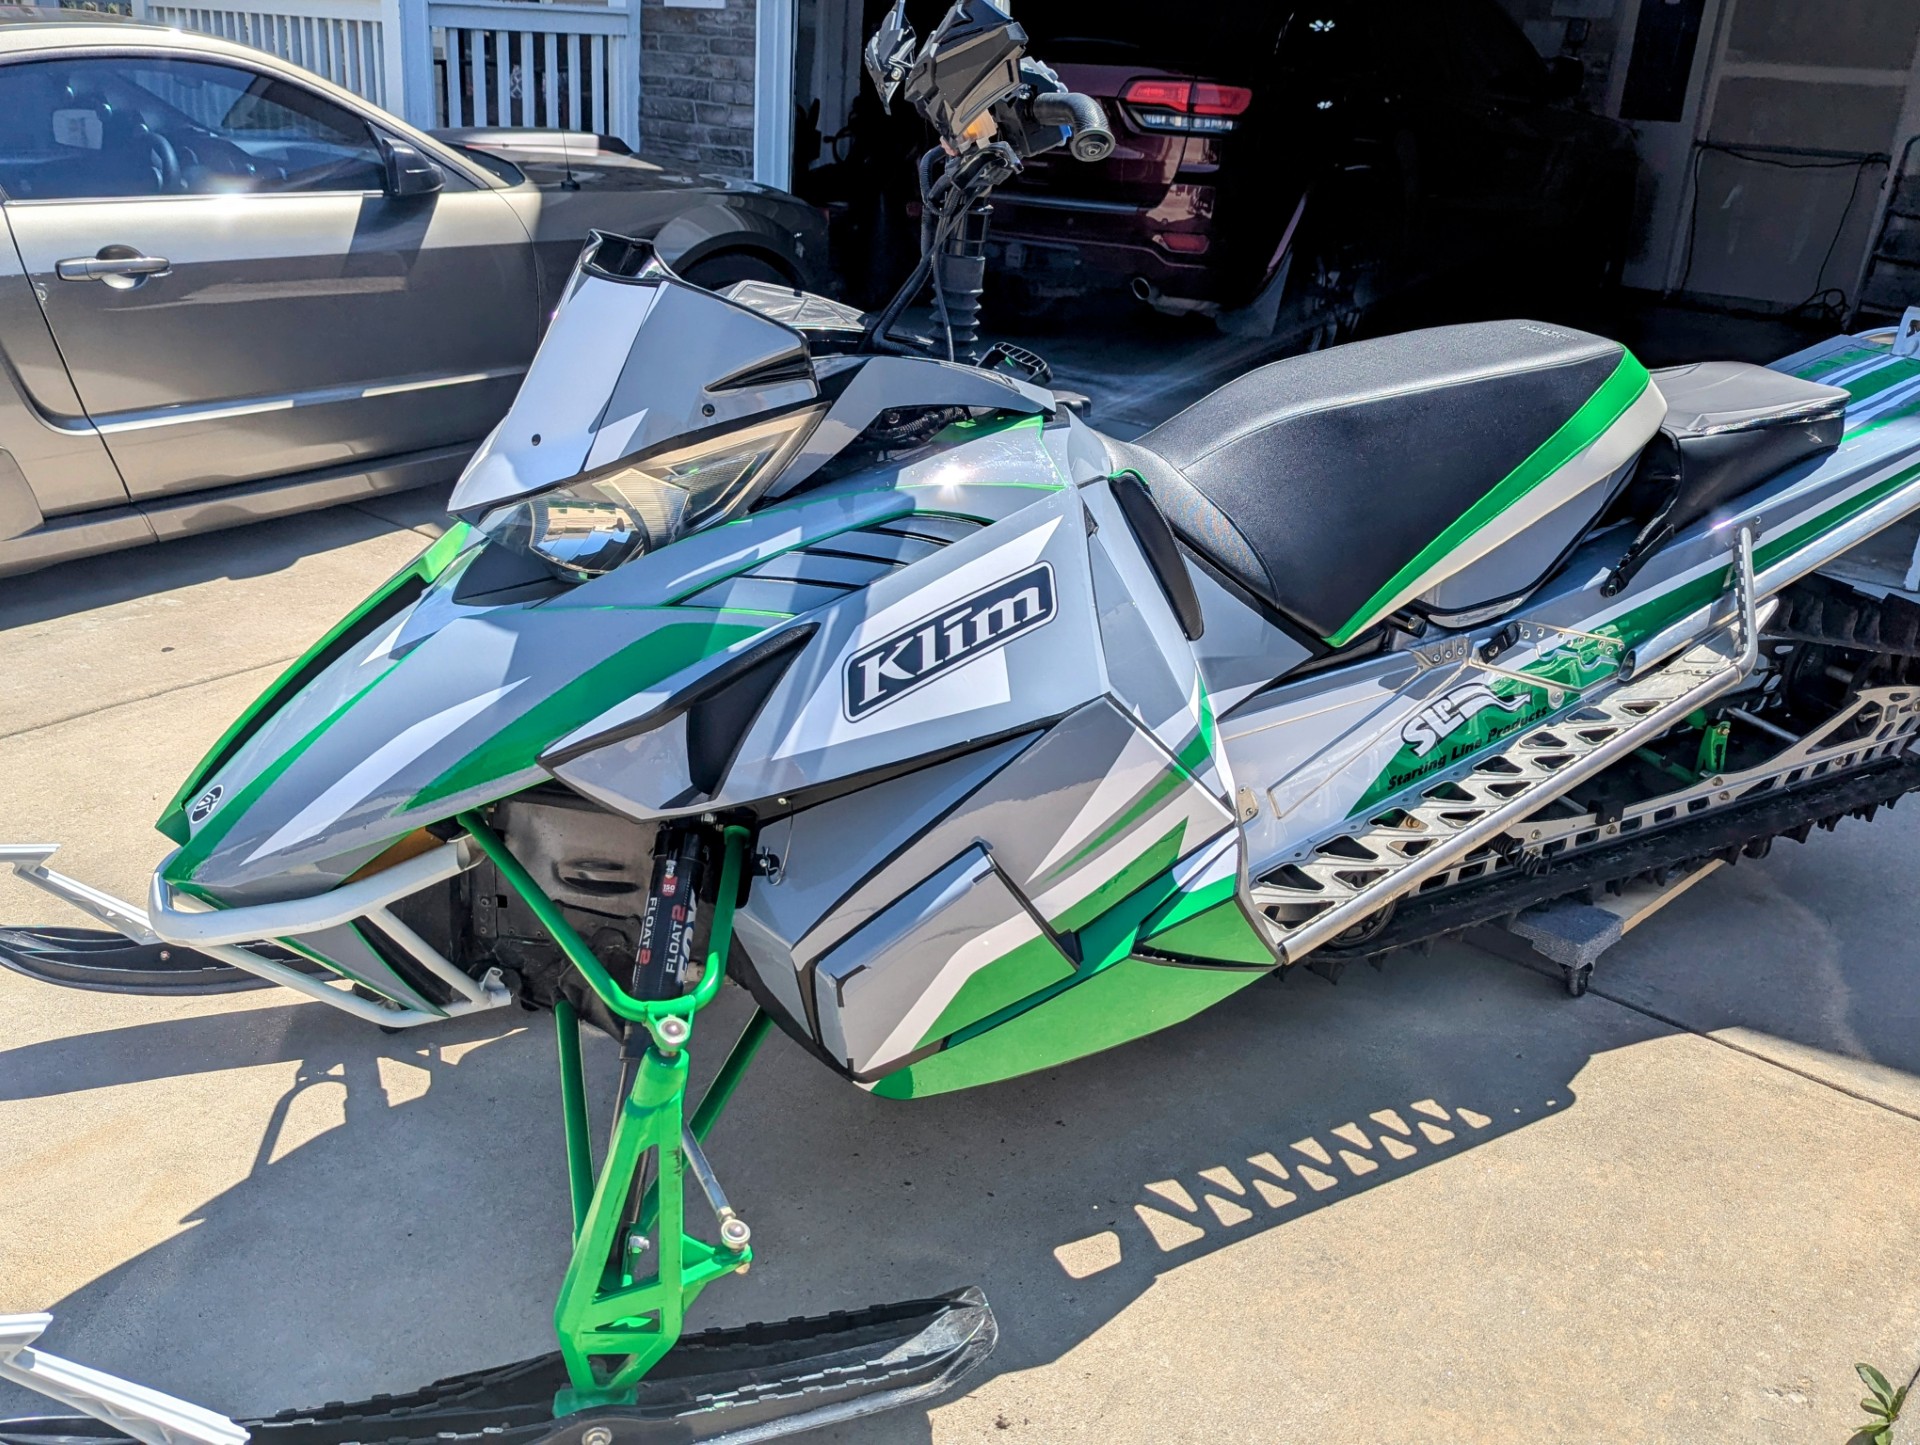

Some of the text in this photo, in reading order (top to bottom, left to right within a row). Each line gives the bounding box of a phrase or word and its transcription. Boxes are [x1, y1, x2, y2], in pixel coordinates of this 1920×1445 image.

[858, 586, 1047, 706] Klim
[1387, 705, 1549, 791] Starting Line Products
